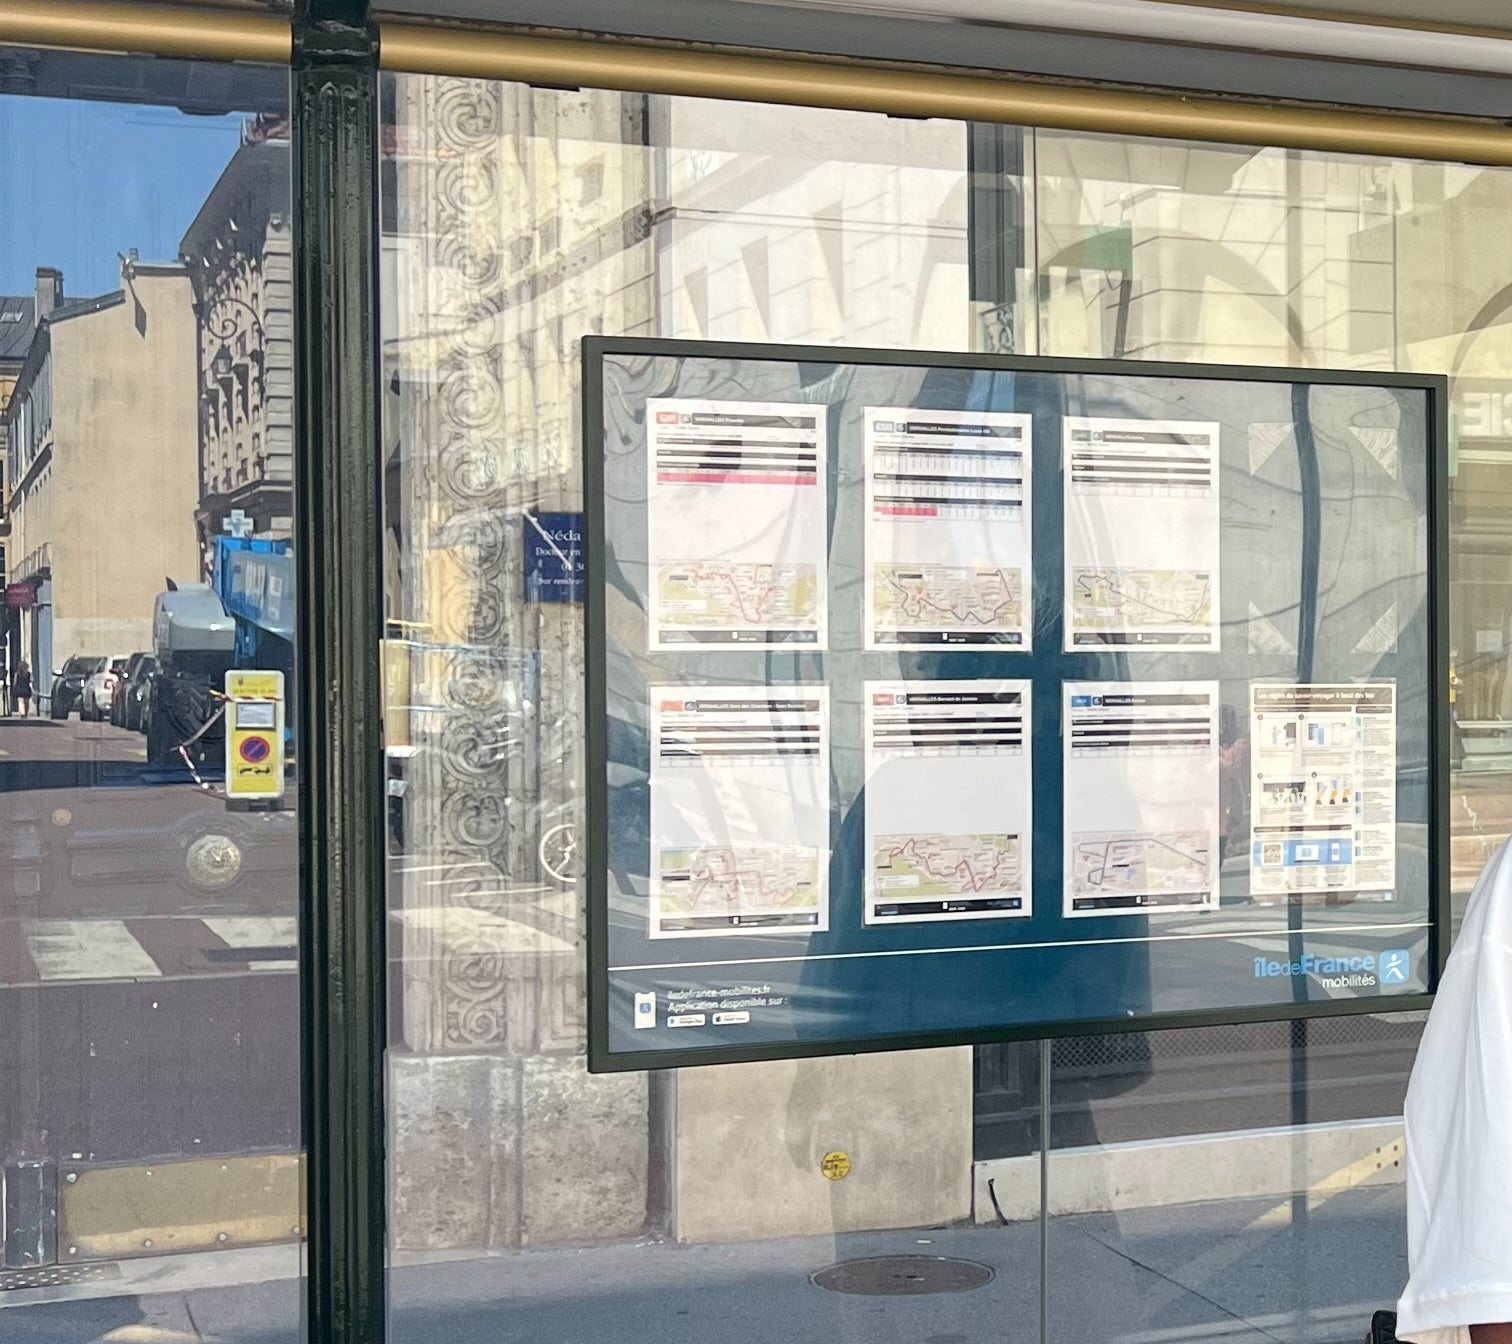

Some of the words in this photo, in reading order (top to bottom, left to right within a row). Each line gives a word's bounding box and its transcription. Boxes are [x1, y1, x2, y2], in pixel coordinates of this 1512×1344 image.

[1321, 973, 1376, 988] mobilités
[667, 1001, 719, 1014] Application
[720, 998, 766, 1010] disponible
